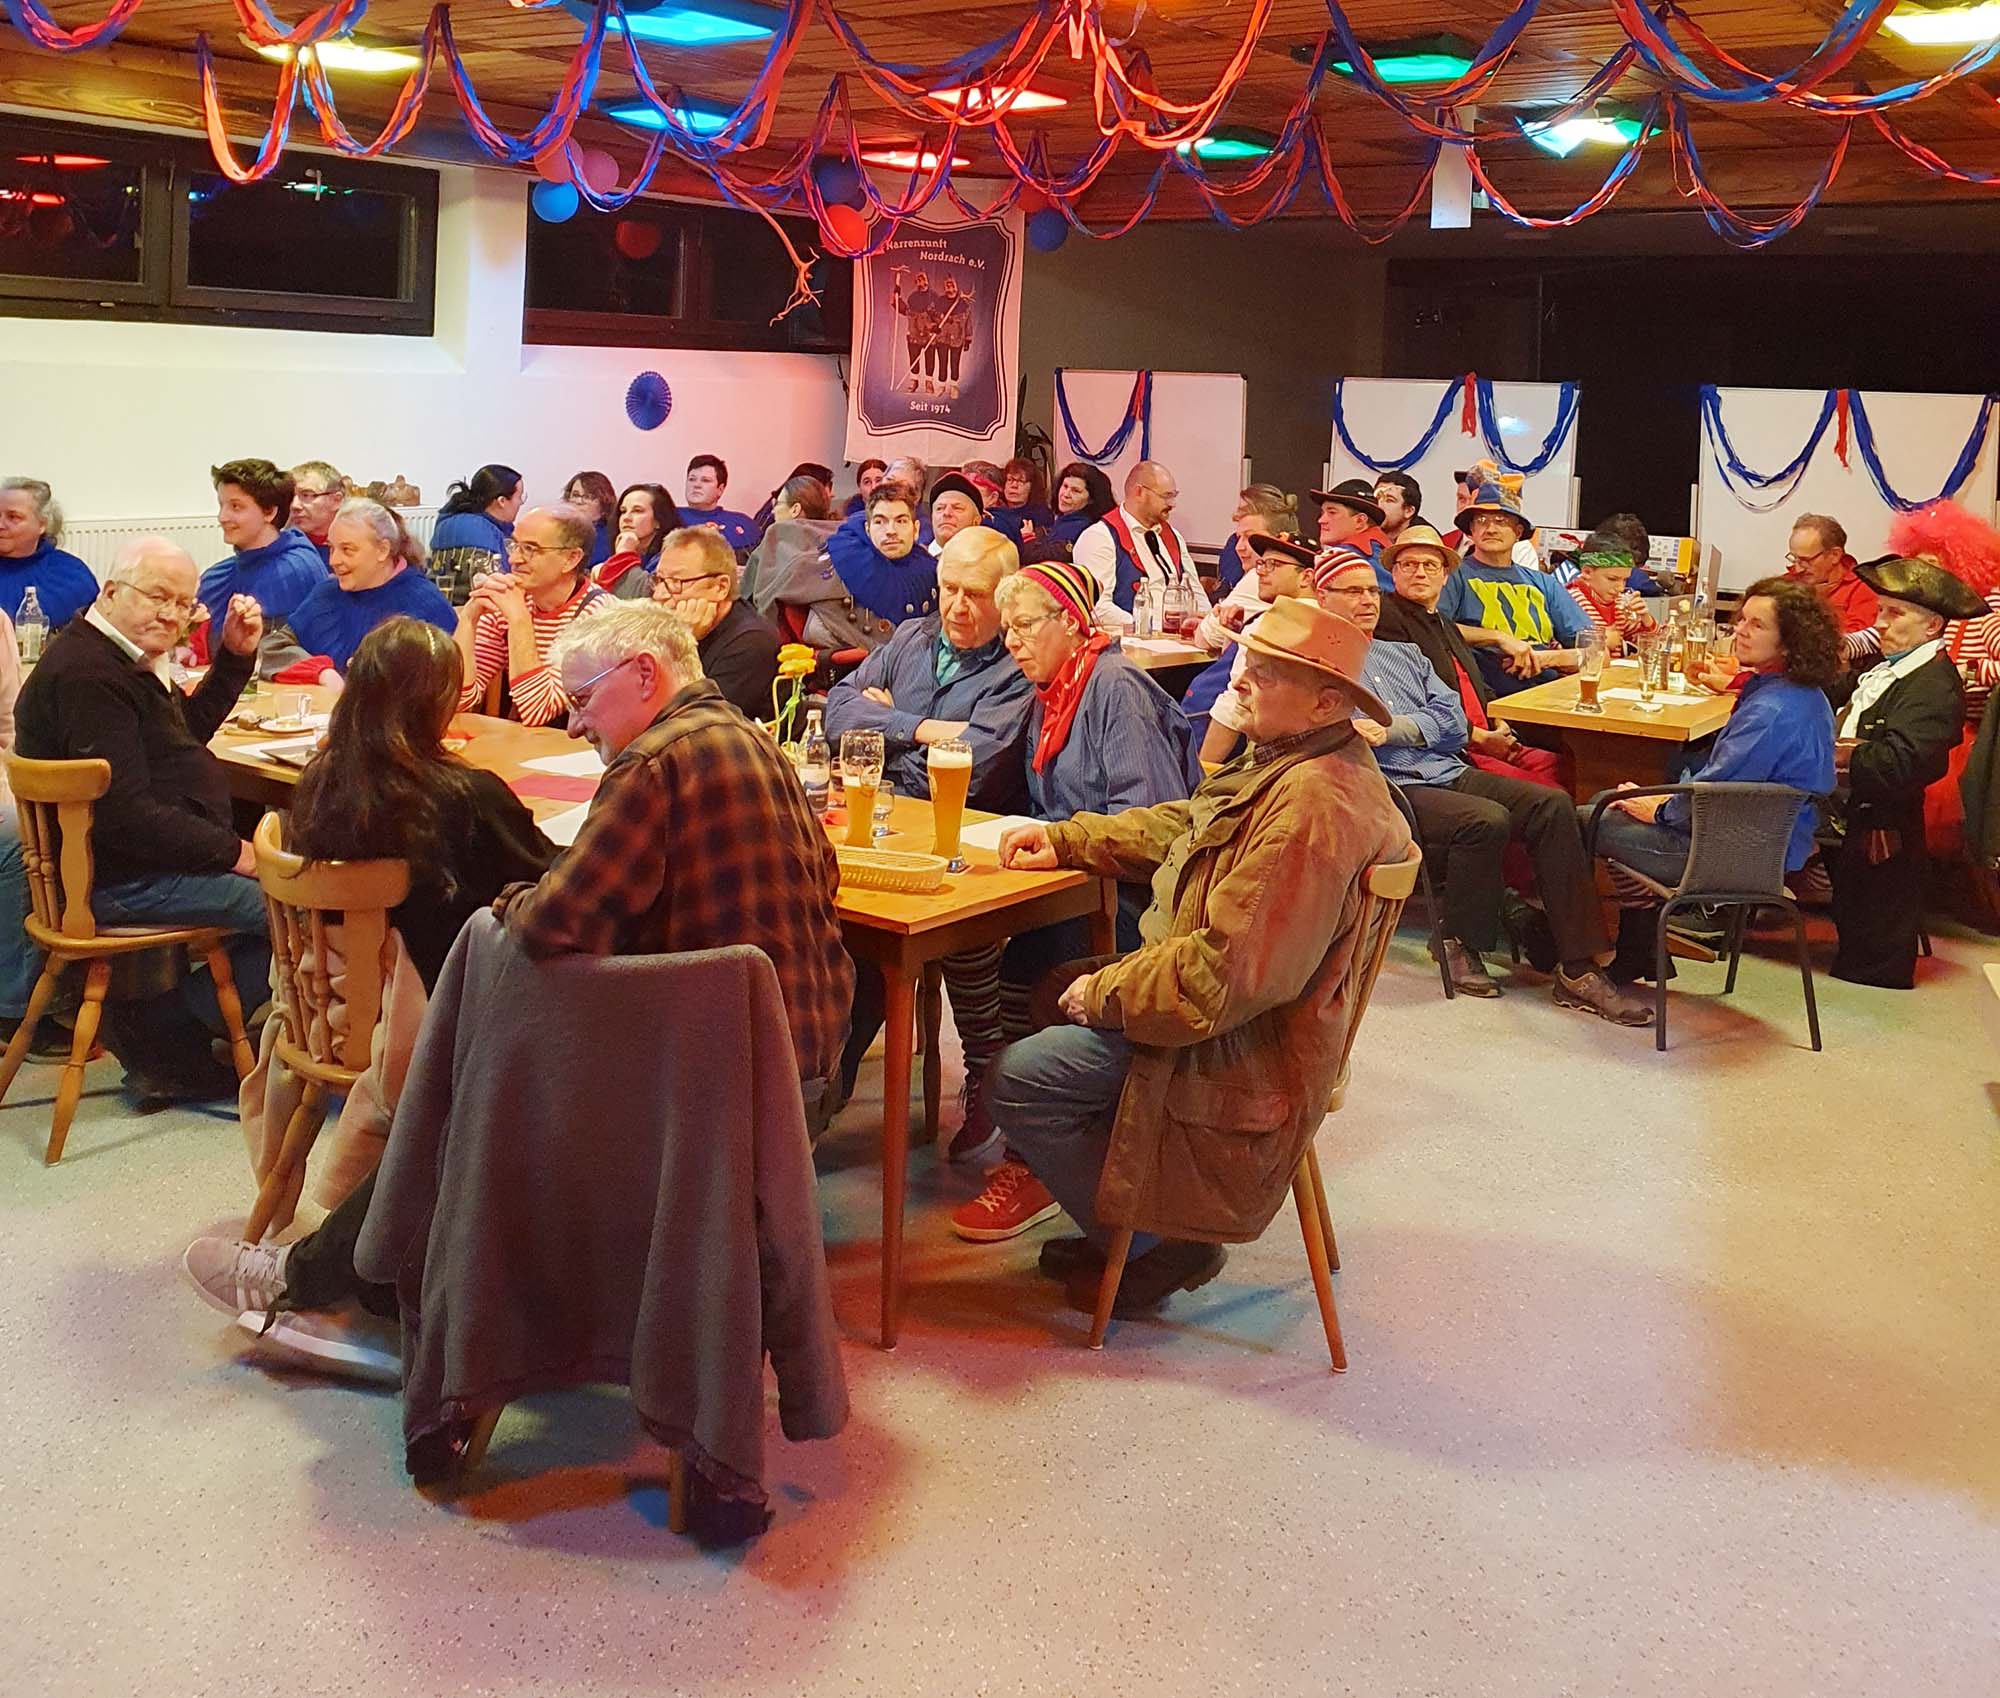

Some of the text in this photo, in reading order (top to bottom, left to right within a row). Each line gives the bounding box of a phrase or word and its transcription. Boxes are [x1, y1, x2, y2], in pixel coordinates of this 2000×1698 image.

[886, 238, 948, 250] Narrenzunft
[919, 251, 986, 270] Nordrach e.V.
[910, 401, 951, 414] Seit 1974
